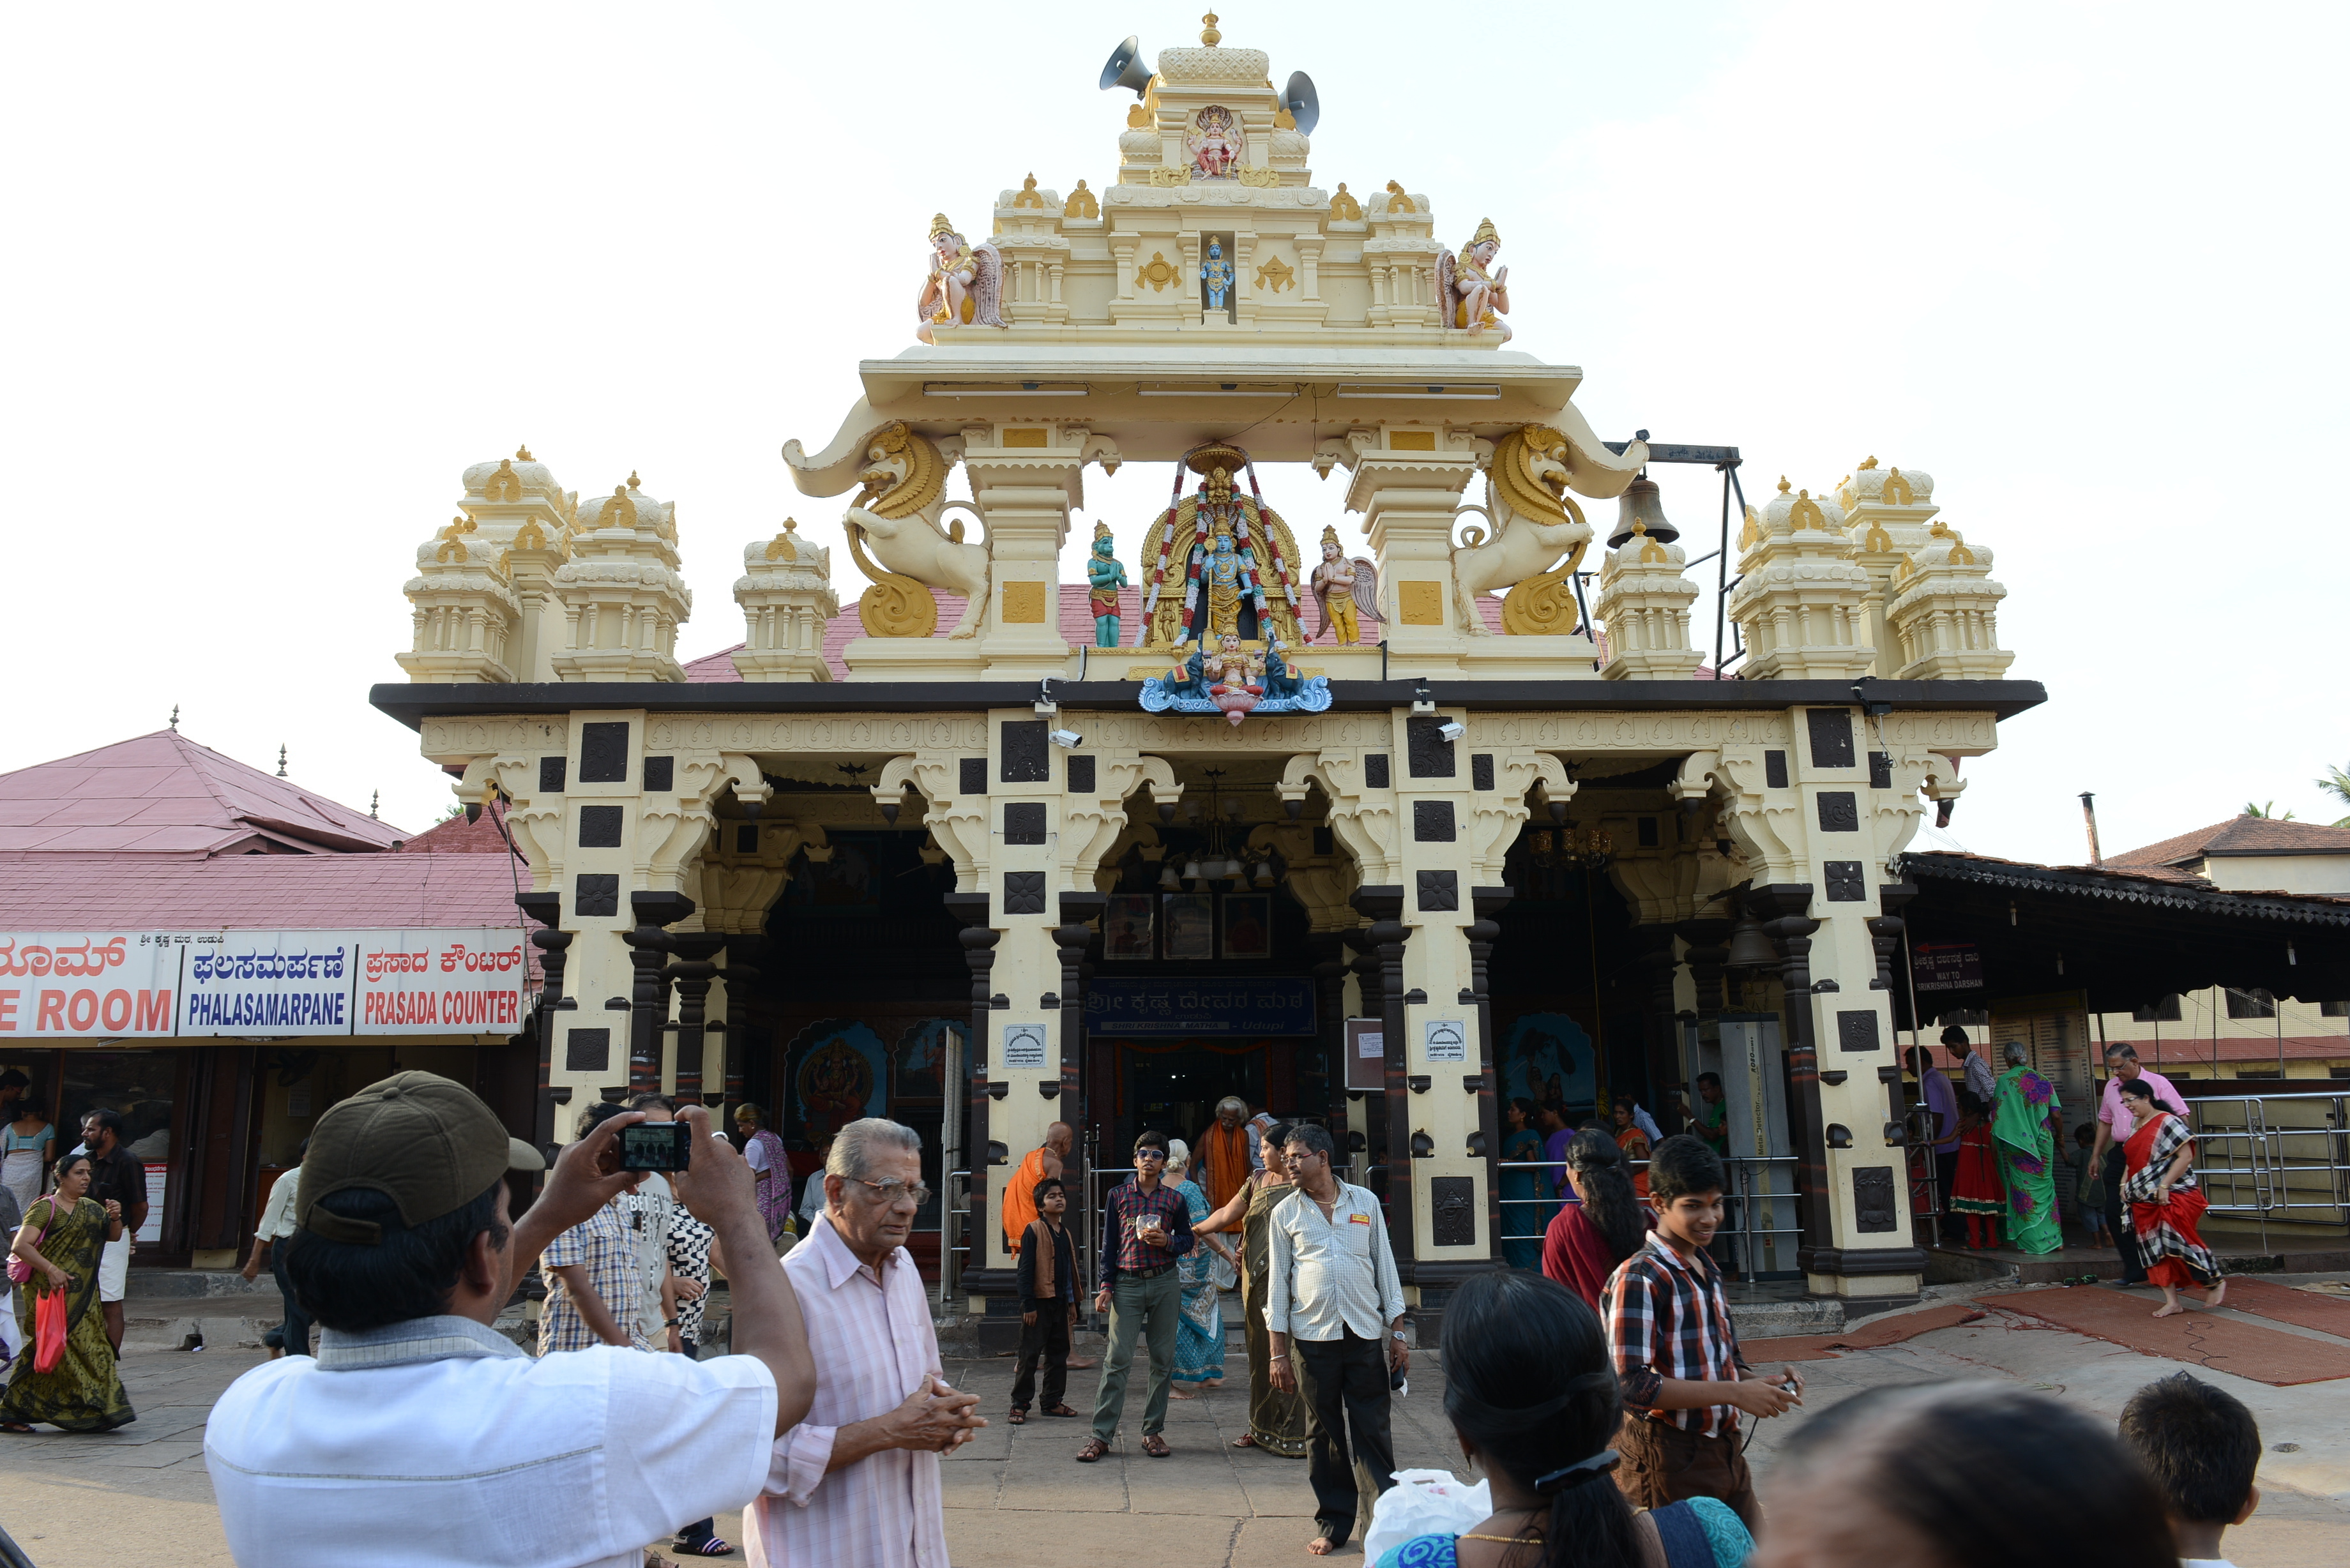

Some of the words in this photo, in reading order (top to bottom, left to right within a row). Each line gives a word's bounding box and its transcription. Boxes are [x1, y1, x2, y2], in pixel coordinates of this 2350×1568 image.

[193, 946, 345, 984] ಫಲಸಮರ್ಪಣೆ
[366, 946, 429, 983] ಪ್ರಸಾದ
[440, 944, 522, 972] ಕೌಂಟರ್
[1936, 972, 1950, 981] WAY
[1951, 971, 1960, 979] TO
[1916, 981, 1953, 991] SRIKRISHNA
[1954, 979, 1983, 989] DARSHAN
[36, 988, 171, 1031] ROOM
[188, 992, 345, 1026] PHALASAMARPANE
[365, 991, 437, 1025] PRASADA
[442, 990, 518, 1025] COUNTER
[1242, 1021, 1285, 1032] Udupi
